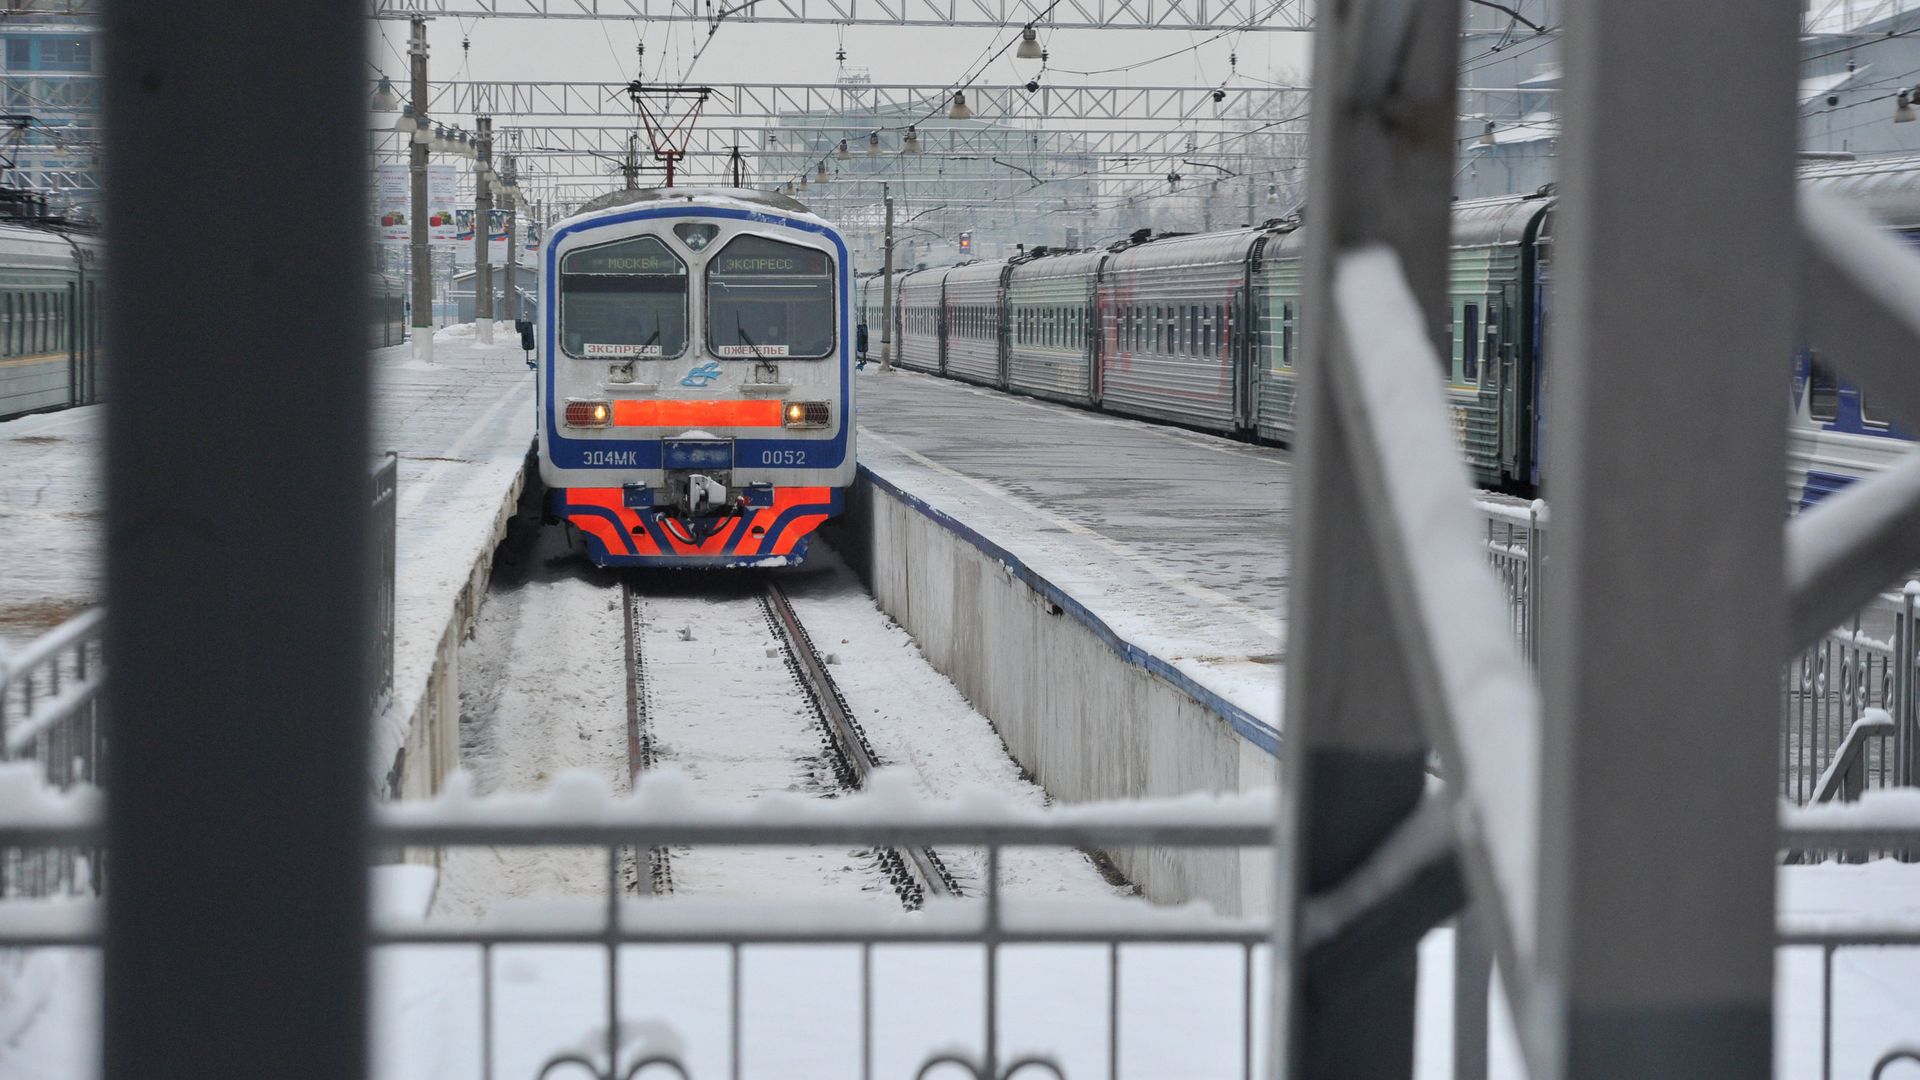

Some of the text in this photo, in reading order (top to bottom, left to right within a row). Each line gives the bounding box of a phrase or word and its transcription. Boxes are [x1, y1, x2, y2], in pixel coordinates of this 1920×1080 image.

[726, 258, 793, 270] ЭКСПРЕСС
[587, 344, 658, 355] ЭКСПРЕСС
[583, 450, 638, 466] ЭД4МК
[762, 450, 806, 465] 0052
